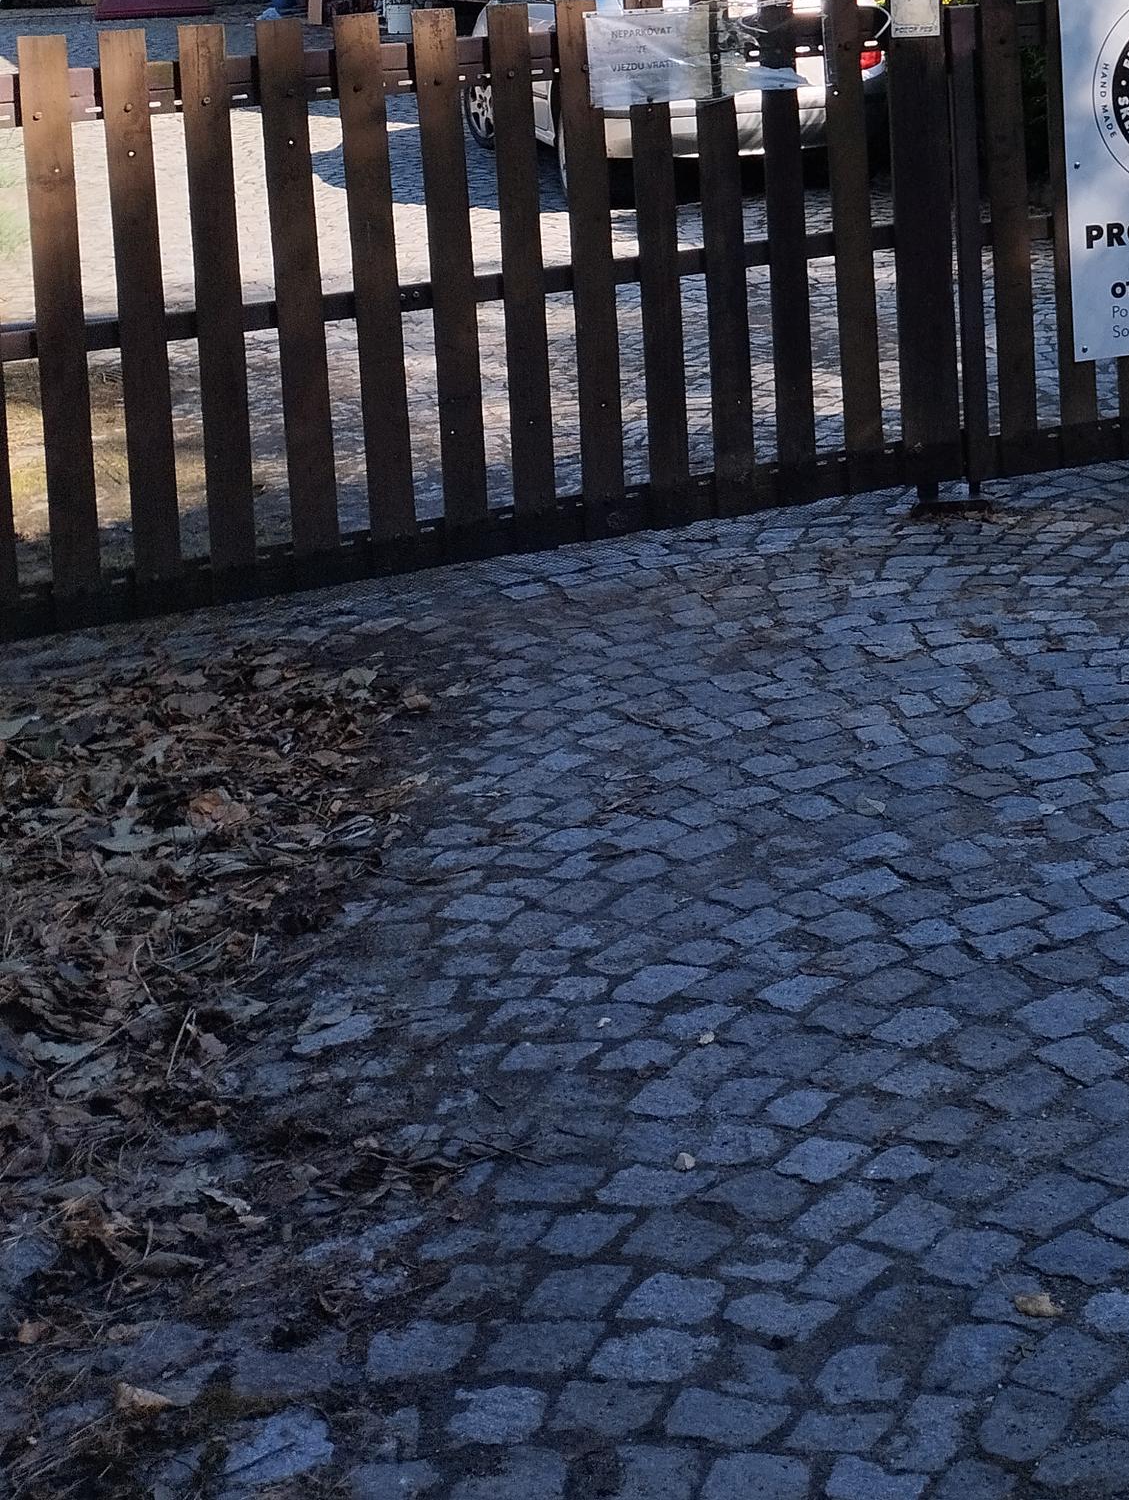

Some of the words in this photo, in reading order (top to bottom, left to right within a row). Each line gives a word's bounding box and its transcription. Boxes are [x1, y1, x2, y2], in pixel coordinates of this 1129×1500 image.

[1100, 63, 1109, 98] HAND
[1101, 104, 1117, 138] MADE
[1112, 305, 1128, 318] Po
[1112, 325, 1129, 338] So
